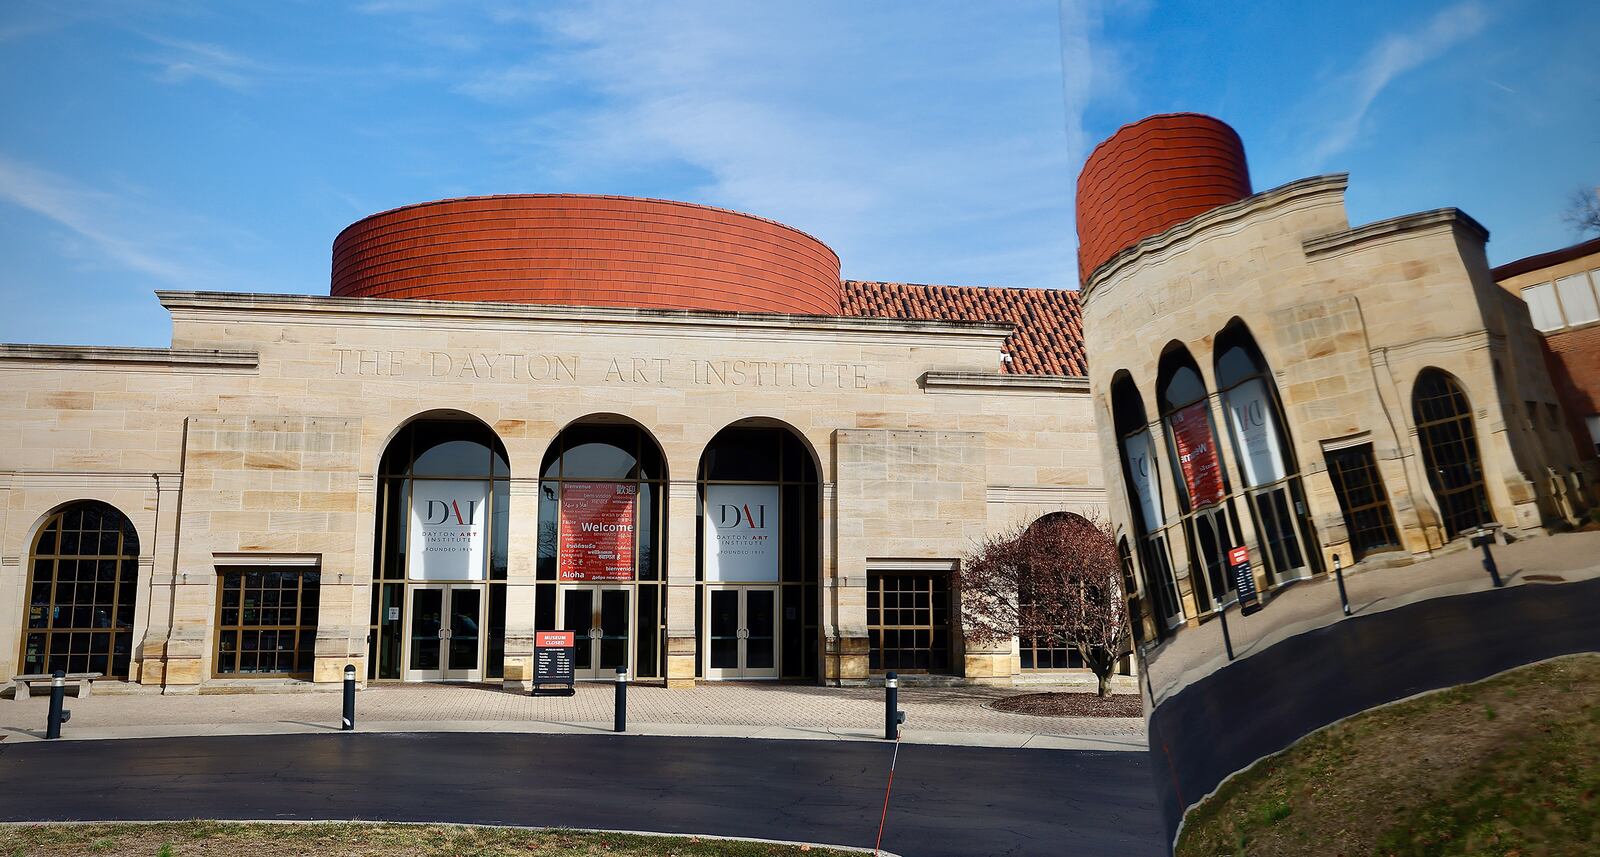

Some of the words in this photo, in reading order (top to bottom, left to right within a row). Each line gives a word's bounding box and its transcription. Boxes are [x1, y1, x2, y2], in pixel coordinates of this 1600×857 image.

[332, 349, 405, 376] THE
[428, 351, 578, 382] DAYTON
[601, 357, 671, 383] ART
[690, 359, 869, 389] INSTITUTE
[424, 499, 477, 525] DAI
[718, 504, 768, 528] DAI
[581, 522, 634, 532] Welcome
